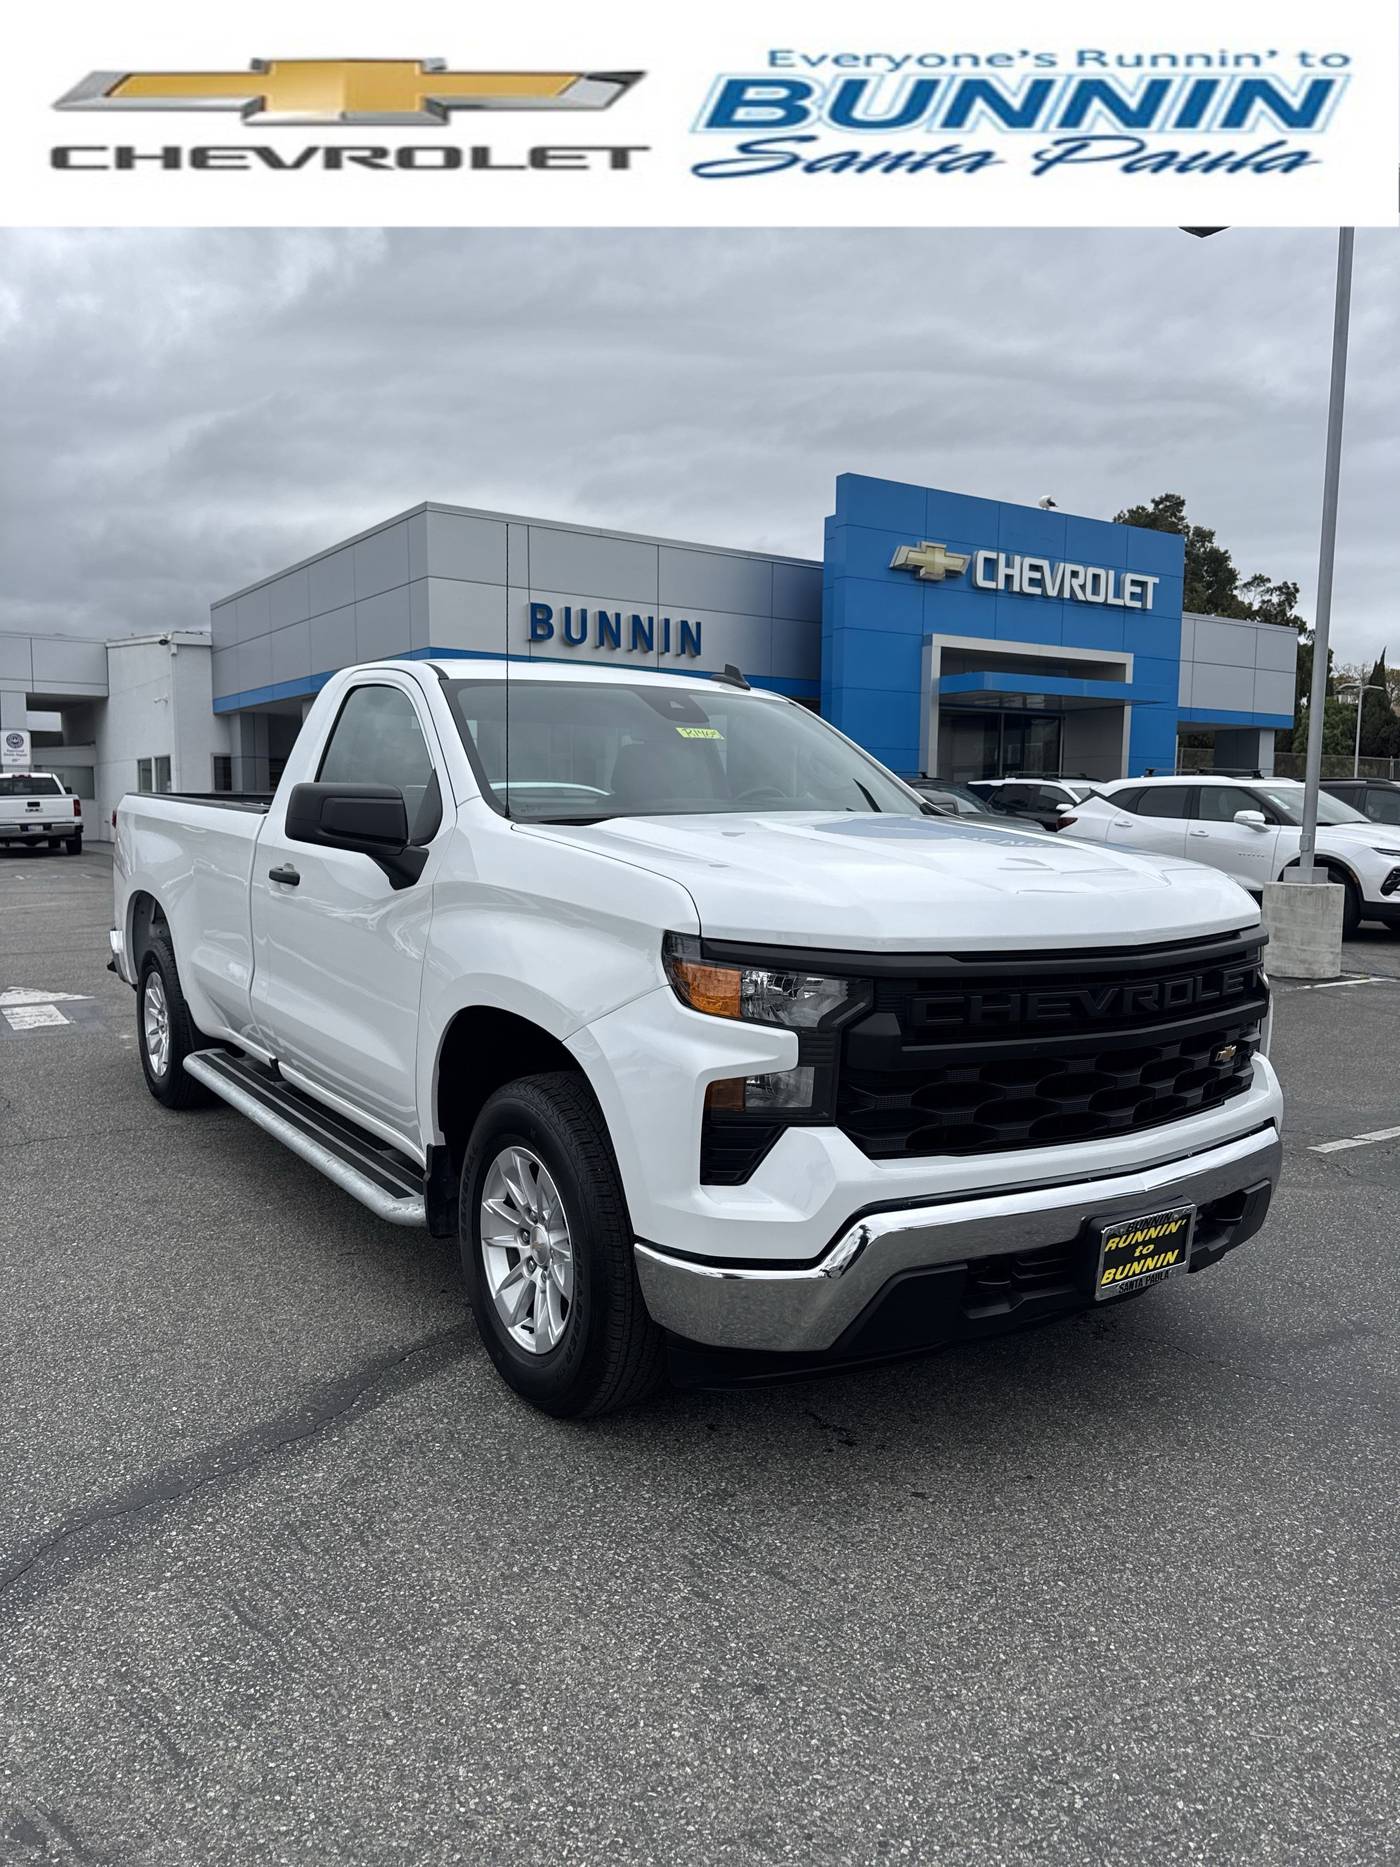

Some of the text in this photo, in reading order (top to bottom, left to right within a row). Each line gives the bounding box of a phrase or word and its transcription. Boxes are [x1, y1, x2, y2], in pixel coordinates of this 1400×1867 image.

[975, 550, 1160, 610] CHEVROLET
[528, 602, 702, 657] BUNNIN
[1101, 1250, 1179, 1285] BUNNIN
[1134, 1244, 1154, 1256] to
[1119, 1270, 1170, 1293] SANTA PAULA
